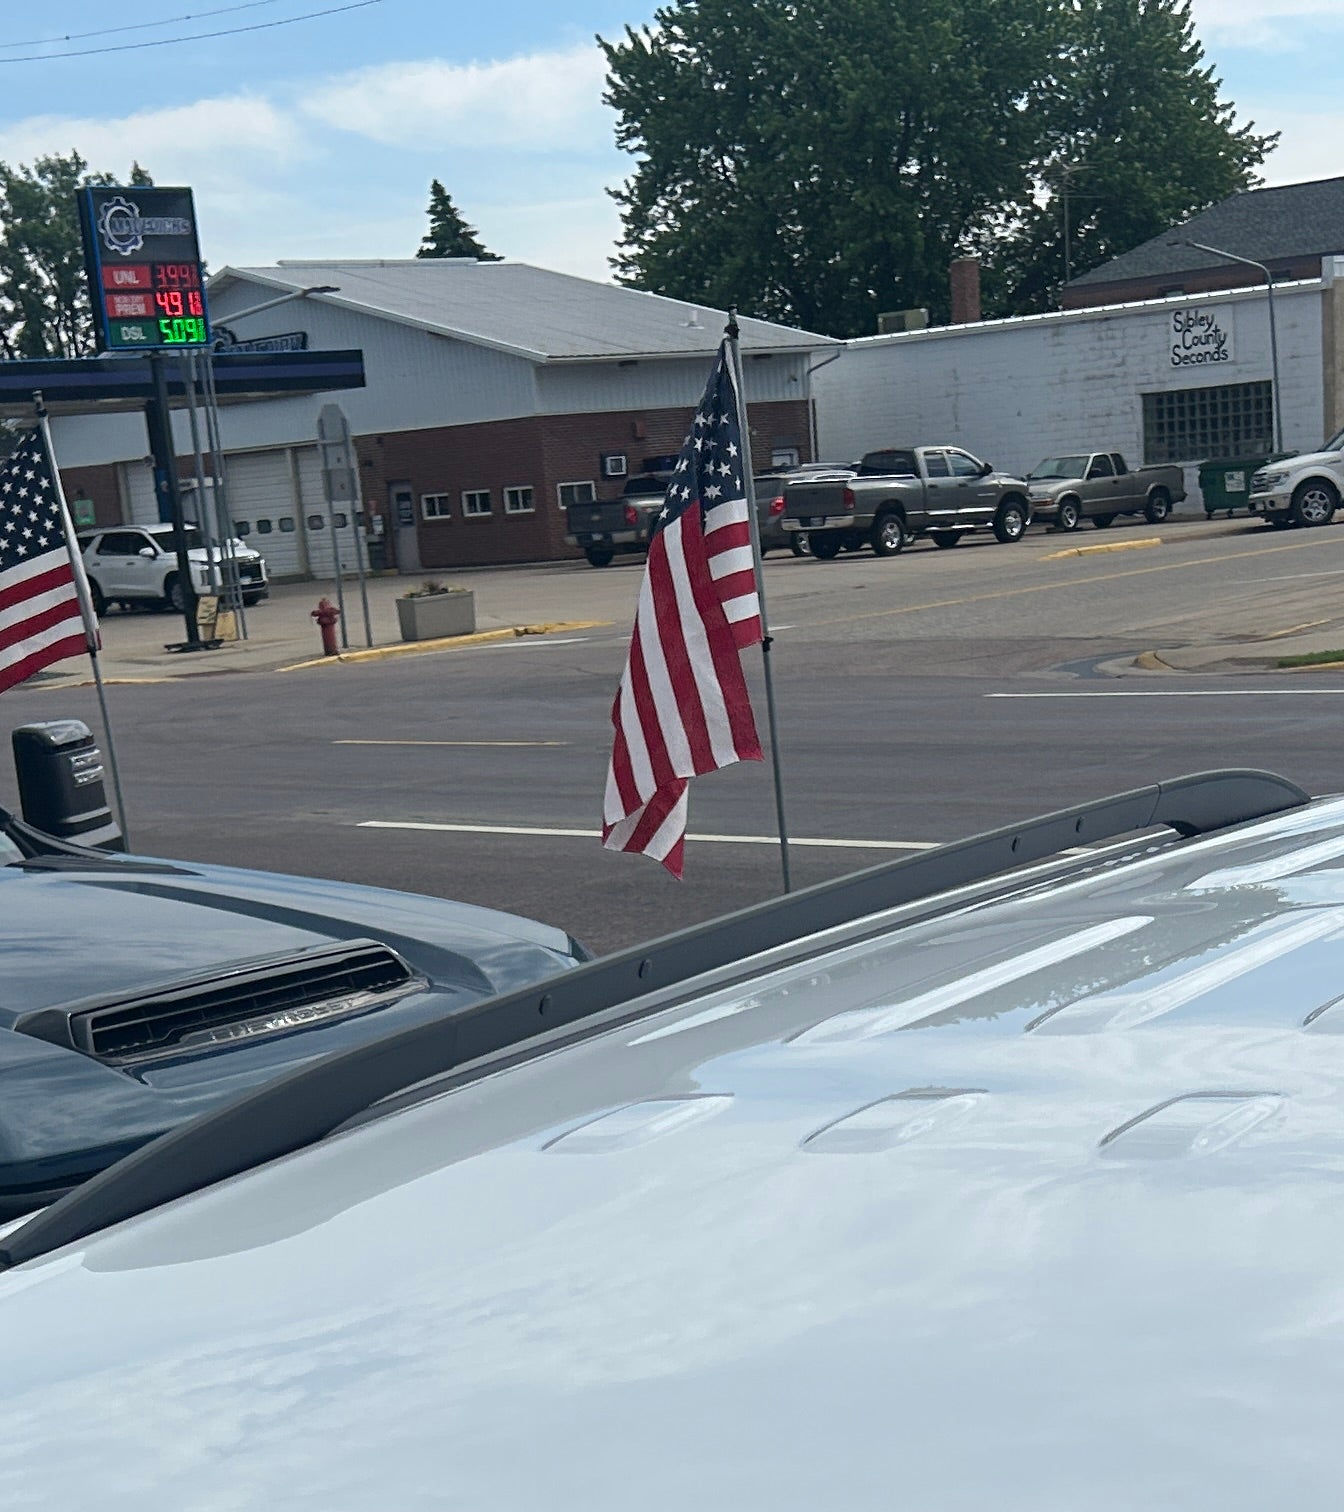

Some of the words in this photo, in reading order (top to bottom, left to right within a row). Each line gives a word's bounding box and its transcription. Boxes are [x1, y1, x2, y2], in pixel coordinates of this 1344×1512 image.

[113, 270, 140, 285] UNL
[1173, 310, 1215, 333] Sibley
[120, 326, 147, 341] DSL
[1182, 324, 1227, 351] County
[1171, 344, 1228, 366] Seconds
